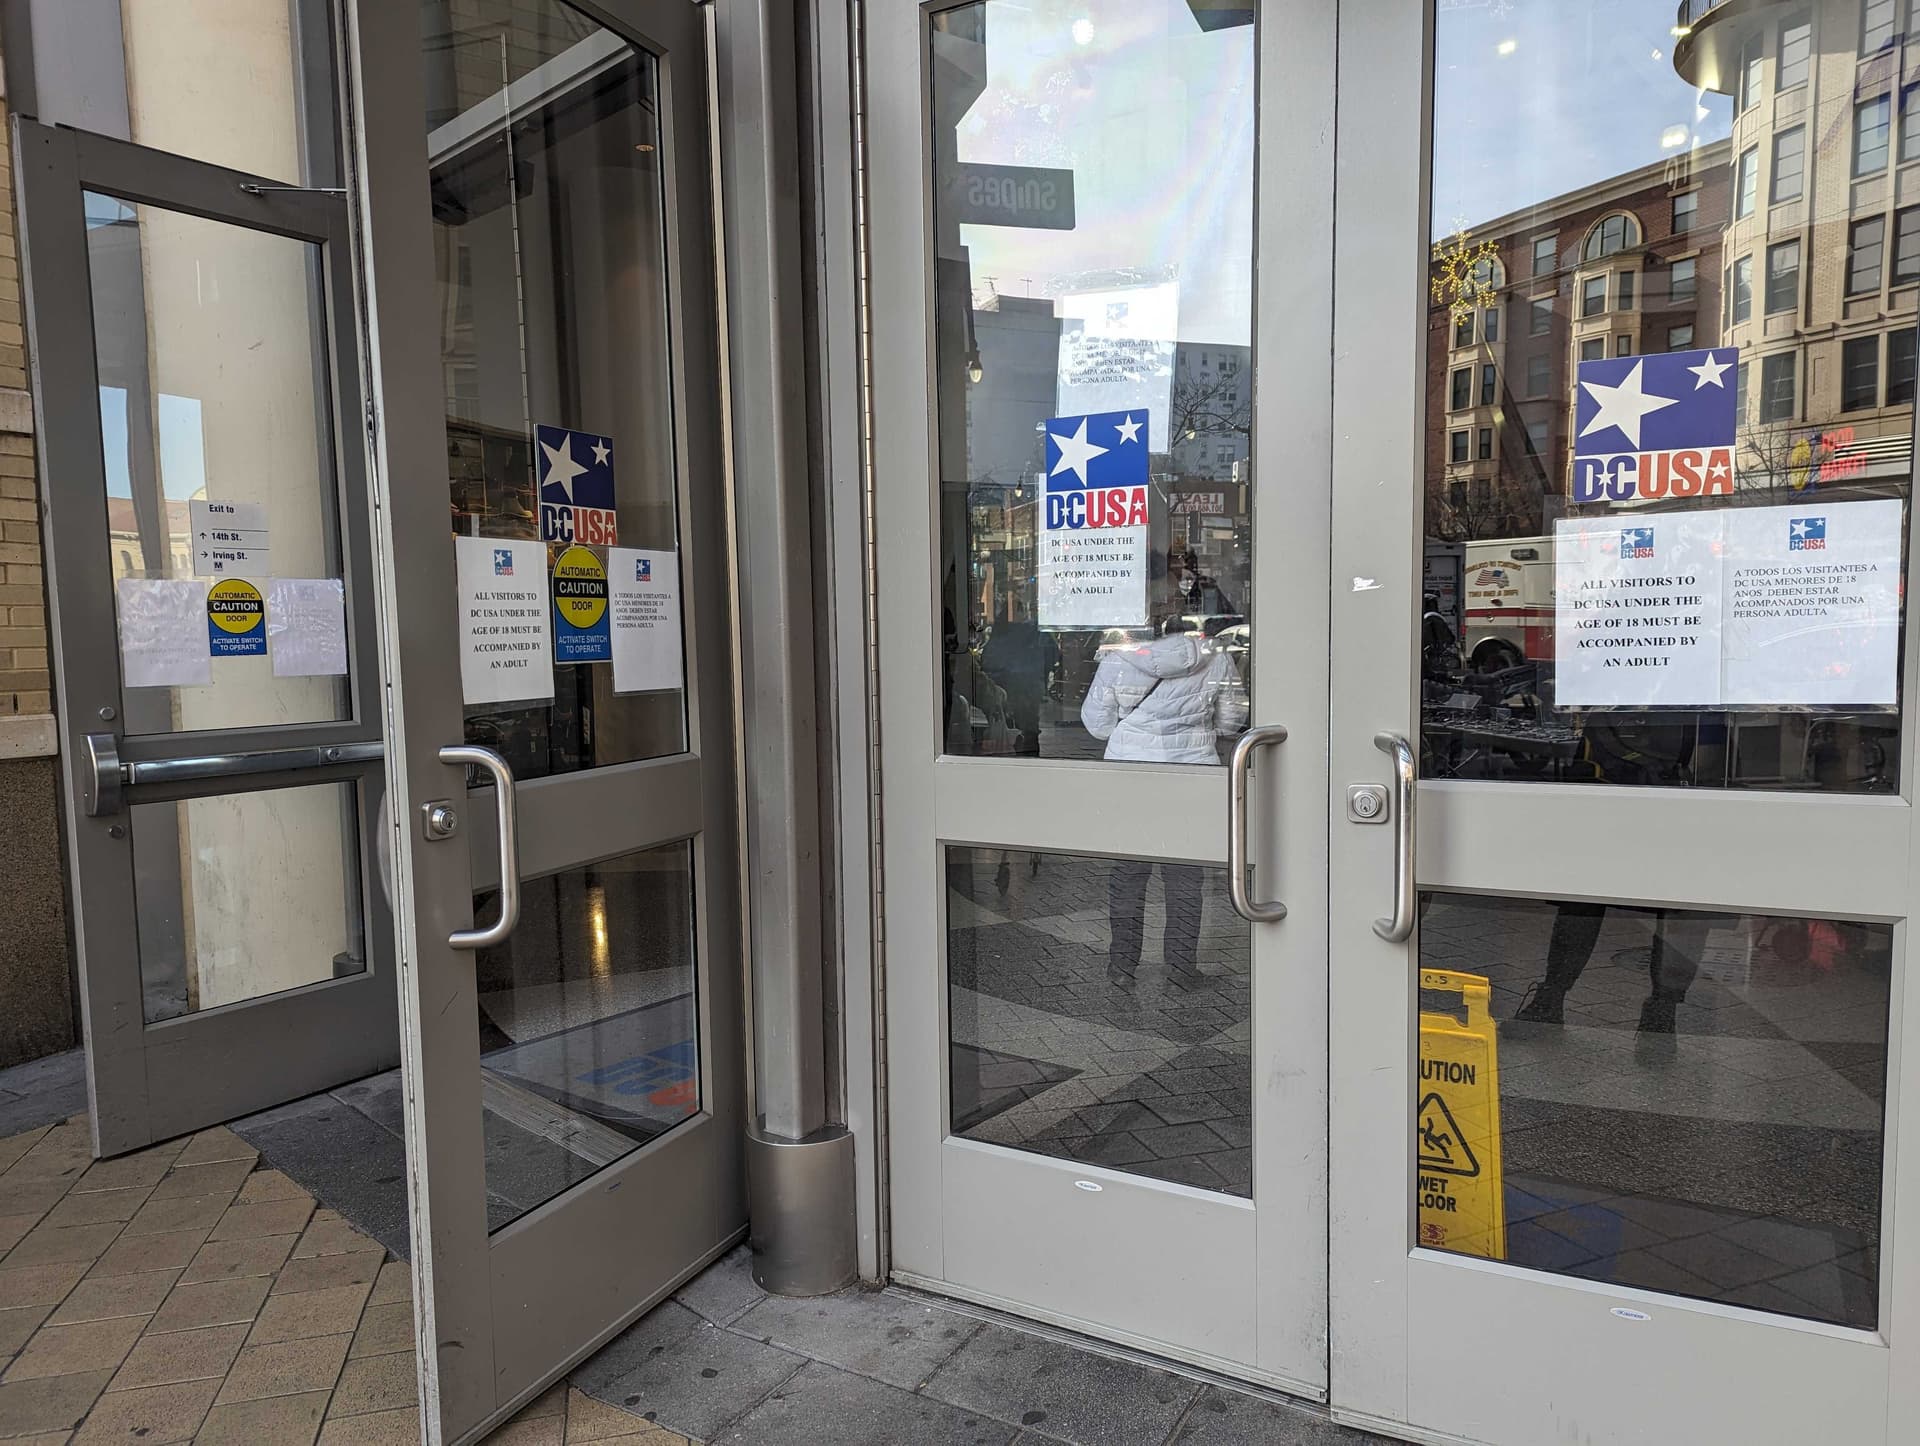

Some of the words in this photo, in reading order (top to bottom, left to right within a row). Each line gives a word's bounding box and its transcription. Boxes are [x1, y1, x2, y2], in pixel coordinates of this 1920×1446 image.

[1101, 375, 1128, 383] ADULTA
[209, 504, 224, 513] Exit
[226, 505, 234, 514] to
[212, 533, 229, 541] 14th
[231, 533, 242, 541] St.
[1085, 538, 1117, 546] UNDER
[1118, 537, 1135, 545] THE
[213, 552, 235, 561] Irving
[237, 552, 248, 560] St.
[1052, 555, 1070, 563] AGE
[1071, 555, 1084, 563] OF
[1096, 554, 1121, 562] MUST
[561, 566, 601, 578] AUTOMATIC
[1053, 570, 1118, 579] ACCOMPANIED
[1744, 568, 1780, 577] TODOS
[1782, 567, 1802, 575] LOS
[1805, 564, 1868, 574] VISITANTES
[1870, 564, 1878, 572] A
[1581, 580, 1607, 590] ALL
[1610, 576, 1673, 588] VISITORS
[1676, 576, 1696, 585] TO
[1734, 579, 1750, 588] DC
[1751, 578, 1772, 587] USA
[1774, 577, 1826, 586] MENORES
[1829, 576, 1843, 584] DE
[1846, 575, 1857, 583] 18
[559, 582, 604, 595] CAUTION
[1084, 586, 1115, 594] ADULT
[1734, 589, 1763, 598] ANOS
[1768, 588, 1803, 597] DEBEN
[1806, 586, 1840, 595] ESTAR
[474, 593, 489, 601] ALL
[491, 593, 526, 601] VISITORS
[527, 593, 537, 601] TO
[1734, 597, 1815, 608] ACOMPANADOS
[1818, 597, 1839, 605] POR
[1842, 596, 1865, 605] UNA
[213, 602, 258, 611] CAUTION
[572, 600, 593, 611] DOOR
[1574, 600, 1592, 610] DC
[1596, 599, 1620, 608] USA
[1624, 597, 1671, 608] UNDER
[1674, 596, 1703, 605] THE
[471, 609, 482, 618] DC
[484, 609, 498, 618] USA
[500, 609, 527, 618] UNDER
[528, 609, 542, 617] THE
[1733, 609, 1781, 618] PERSONA
[1784, 608, 1828, 617] ADULTA
[1575, 620, 1601, 629] AGE
[1604, 619, 1623, 628] OF
[1627, 618, 1639, 627] 18
[1643, 617, 1681, 627] MUST
[1684, 616, 1702, 625] BE
[472, 626, 488, 635] AGE
[489, 626, 500, 635] OF
[502, 626, 509, 634] 18
[511, 626, 531, 634] MUST
[533, 626, 542, 634] BE
[558, 636, 586, 644] ACTIVATE
[586, 635, 608, 644] SWITCH
[1577, 637, 1676, 649] ACCOMPANIED
[1680, 636, 1699, 646] BY
[473, 643, 530, 653] ACCOMPANIED
[532, 643, 541, 651] BY
[565, 645, 574, 654] TO
[575, 644, 602, 653] OPERATE
[490, 660, 501, 669] AN
[503, 660, 528, 669] ADULT
[1603, 658, 1622, 668] AN
[1625, 657, 1671, 667] ADULT
[1419, 1059, 1476, 1085] UTION
